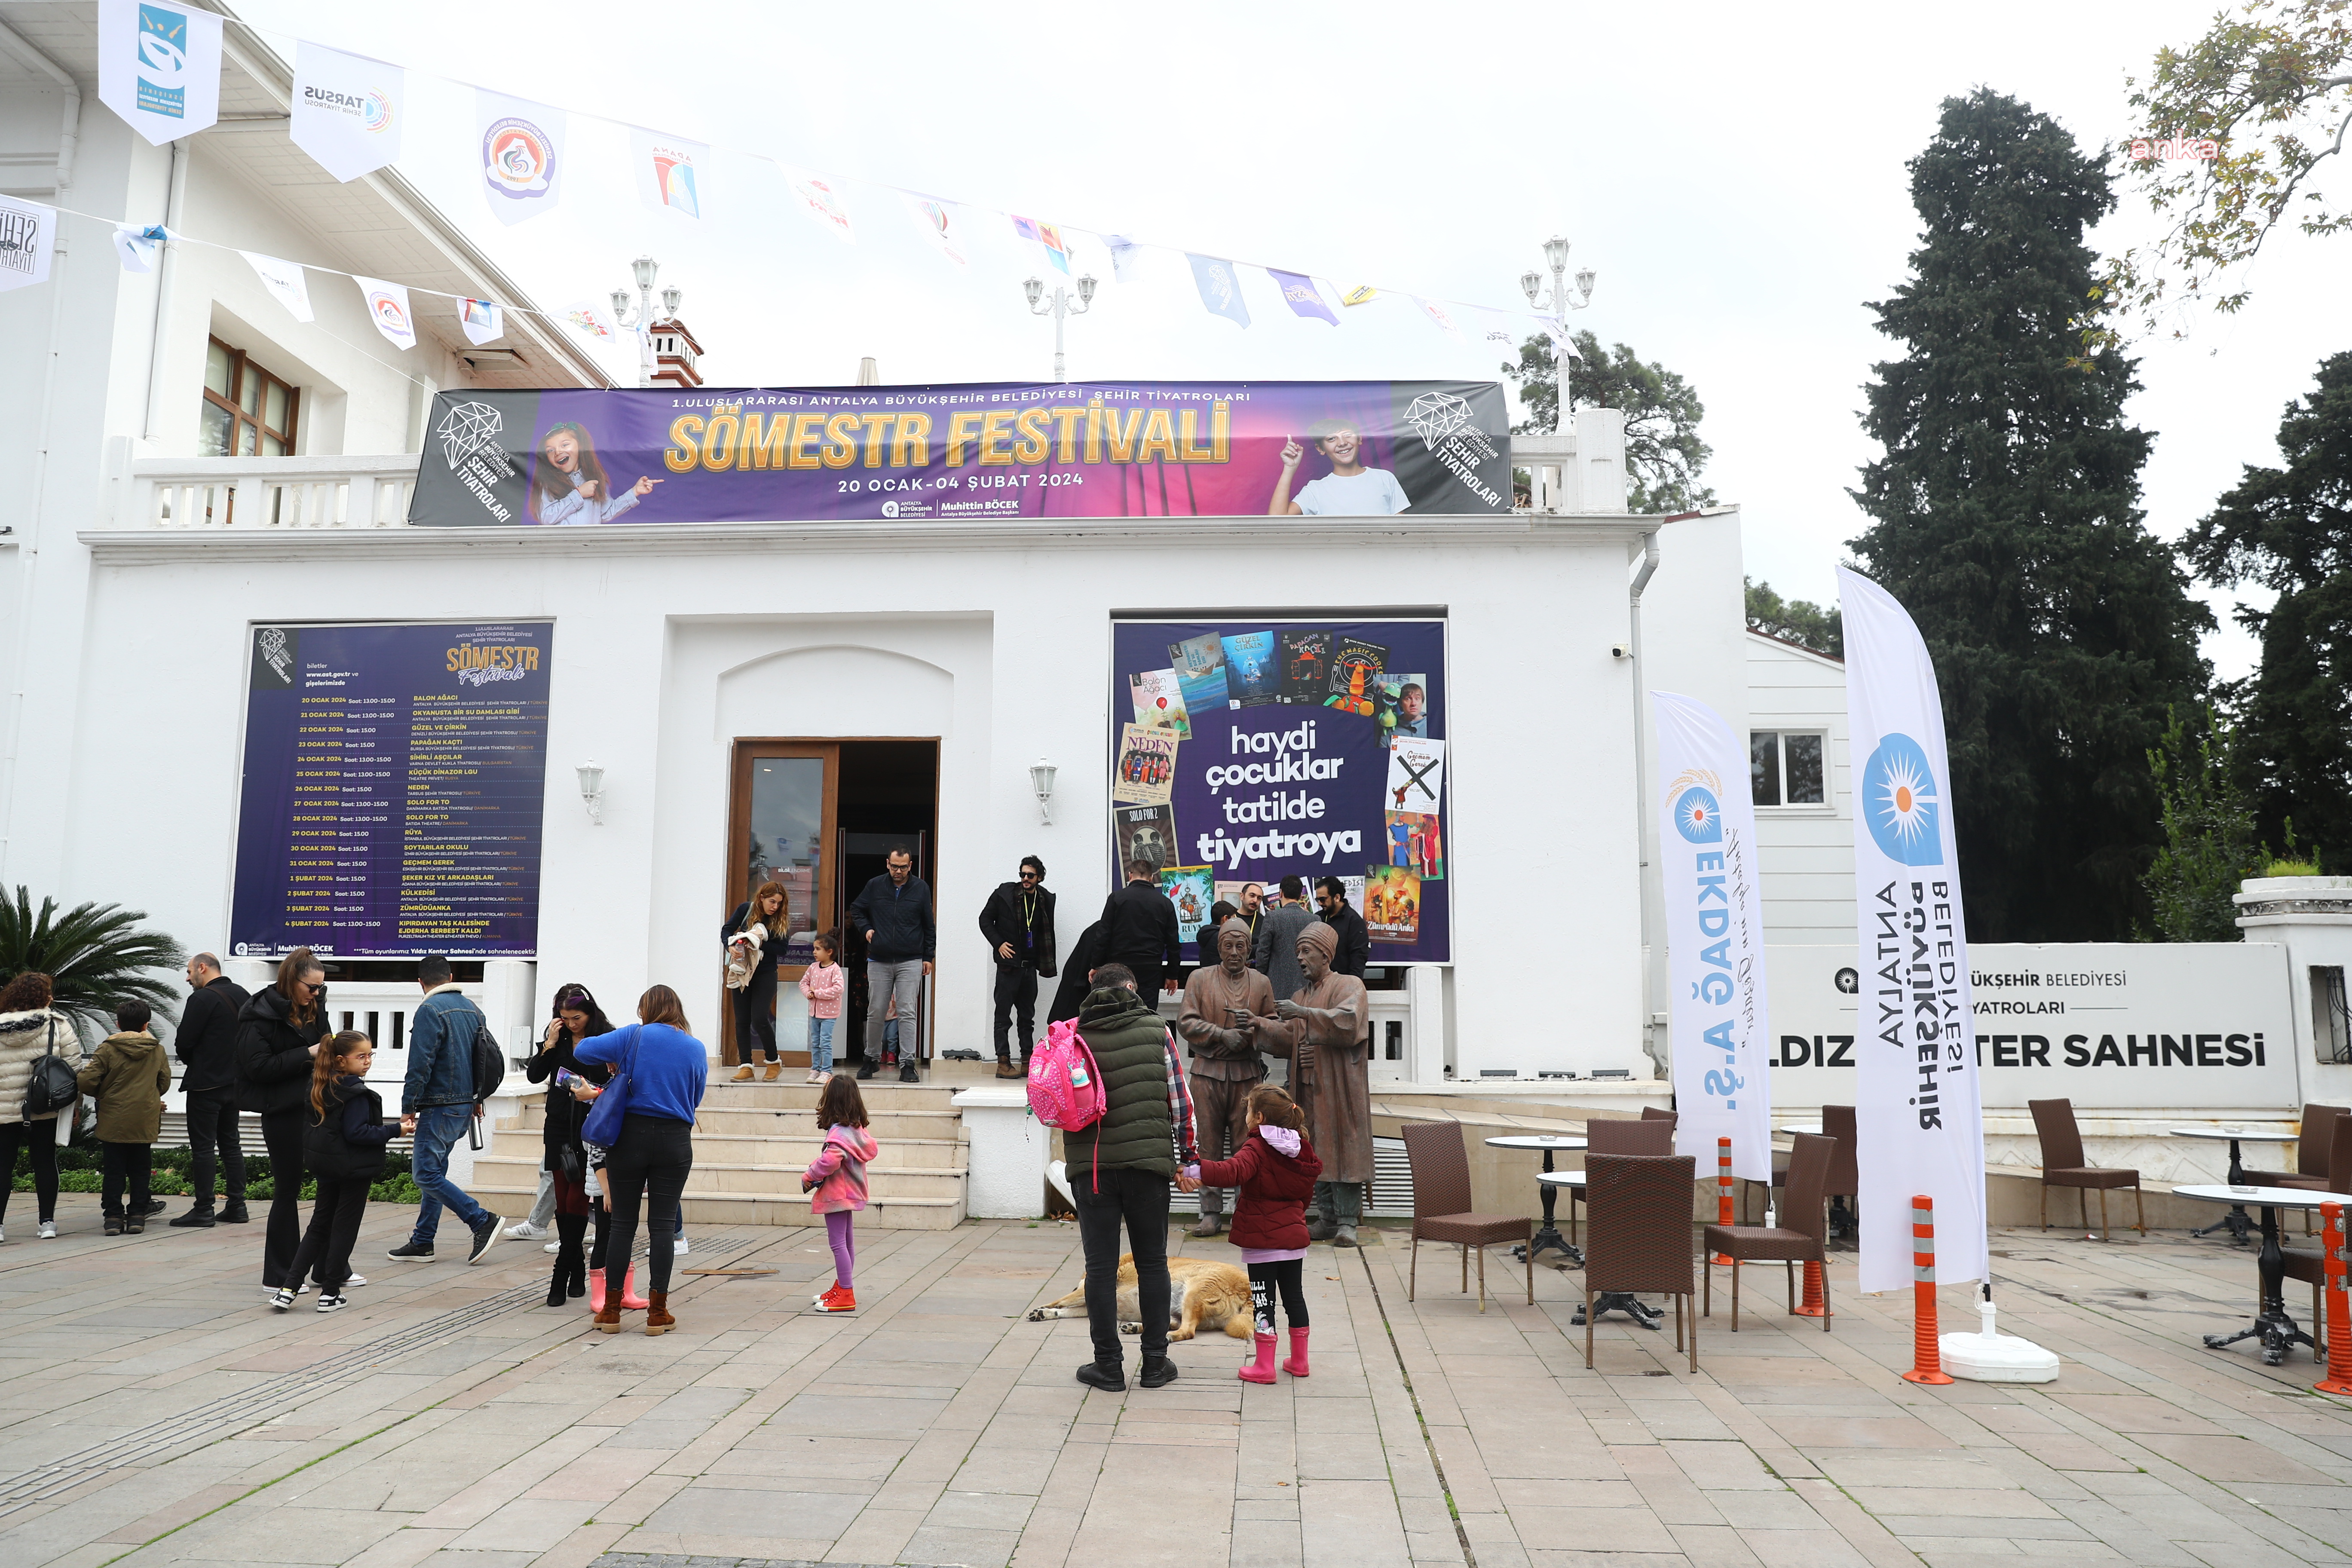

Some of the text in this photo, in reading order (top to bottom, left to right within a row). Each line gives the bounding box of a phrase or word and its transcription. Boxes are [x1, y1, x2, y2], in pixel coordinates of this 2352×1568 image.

[672, 389, 1250, 408] 1.ULUSLARARASI ANTALYA BÜYÜKŞEHİR BELEDİYESİ ŞEHİR TİYATROLARI
[665, 400, 1229, 472] SÖMESTR FESTİVALİ
[1466, 425, 1492, 444] ANTALYA
[490, 441, 510, 462] ANTALYA
[1446, 436, 1480, 470] ŞEHİR
[468, 456, 498, 487] ŞEHİR
[1436, 446, 1502, 507] TİYATROLARI
[839, 481, 860, 492] 20
[968, 475, 1030, 491] ŞUBAT
[1039, 473, 1083, 486] 2024
[457, 466, 511, 522] TİYATROLARI
[941, 499, 1018, 510] Muhittin BÖCEK
[1234, 641, 1264, 652] ÇİRKİN
[1235, 635, 1261, 644] GÜZEL
[1289, 633, 1319, 650] PAPAĞAN
[446, 643, 539, 671] SÖMESTR
[1335, 647, 1384, 675] THE MAGIC COOKS
[458, 663, 525, 687] Festivali
[1142, 677, 1167, 686] Balon
[1143, 685, 1167, 695] Ağacı
[1126, 736, 1175, 756] NEDEN
[1231, 719, 1316, 761] haydi
[1205, 751, 1344, 795] çocuklar
[1129, 807, 1158, 822] SOLO FOR 2
[1222, 789, 1326, 824] tatilde
[1196, 827, 1362, 870] tiyatroya
[1368, 921, 1415, 932] Zümrüdü Anka
[1969, 969, 2127, 989] ÜKŞEHİR BELEDİYESİ
[1769, 1035, 1856, 1067] DIZ
[2064, 1032, 2266, 1067] SAHNESİ
